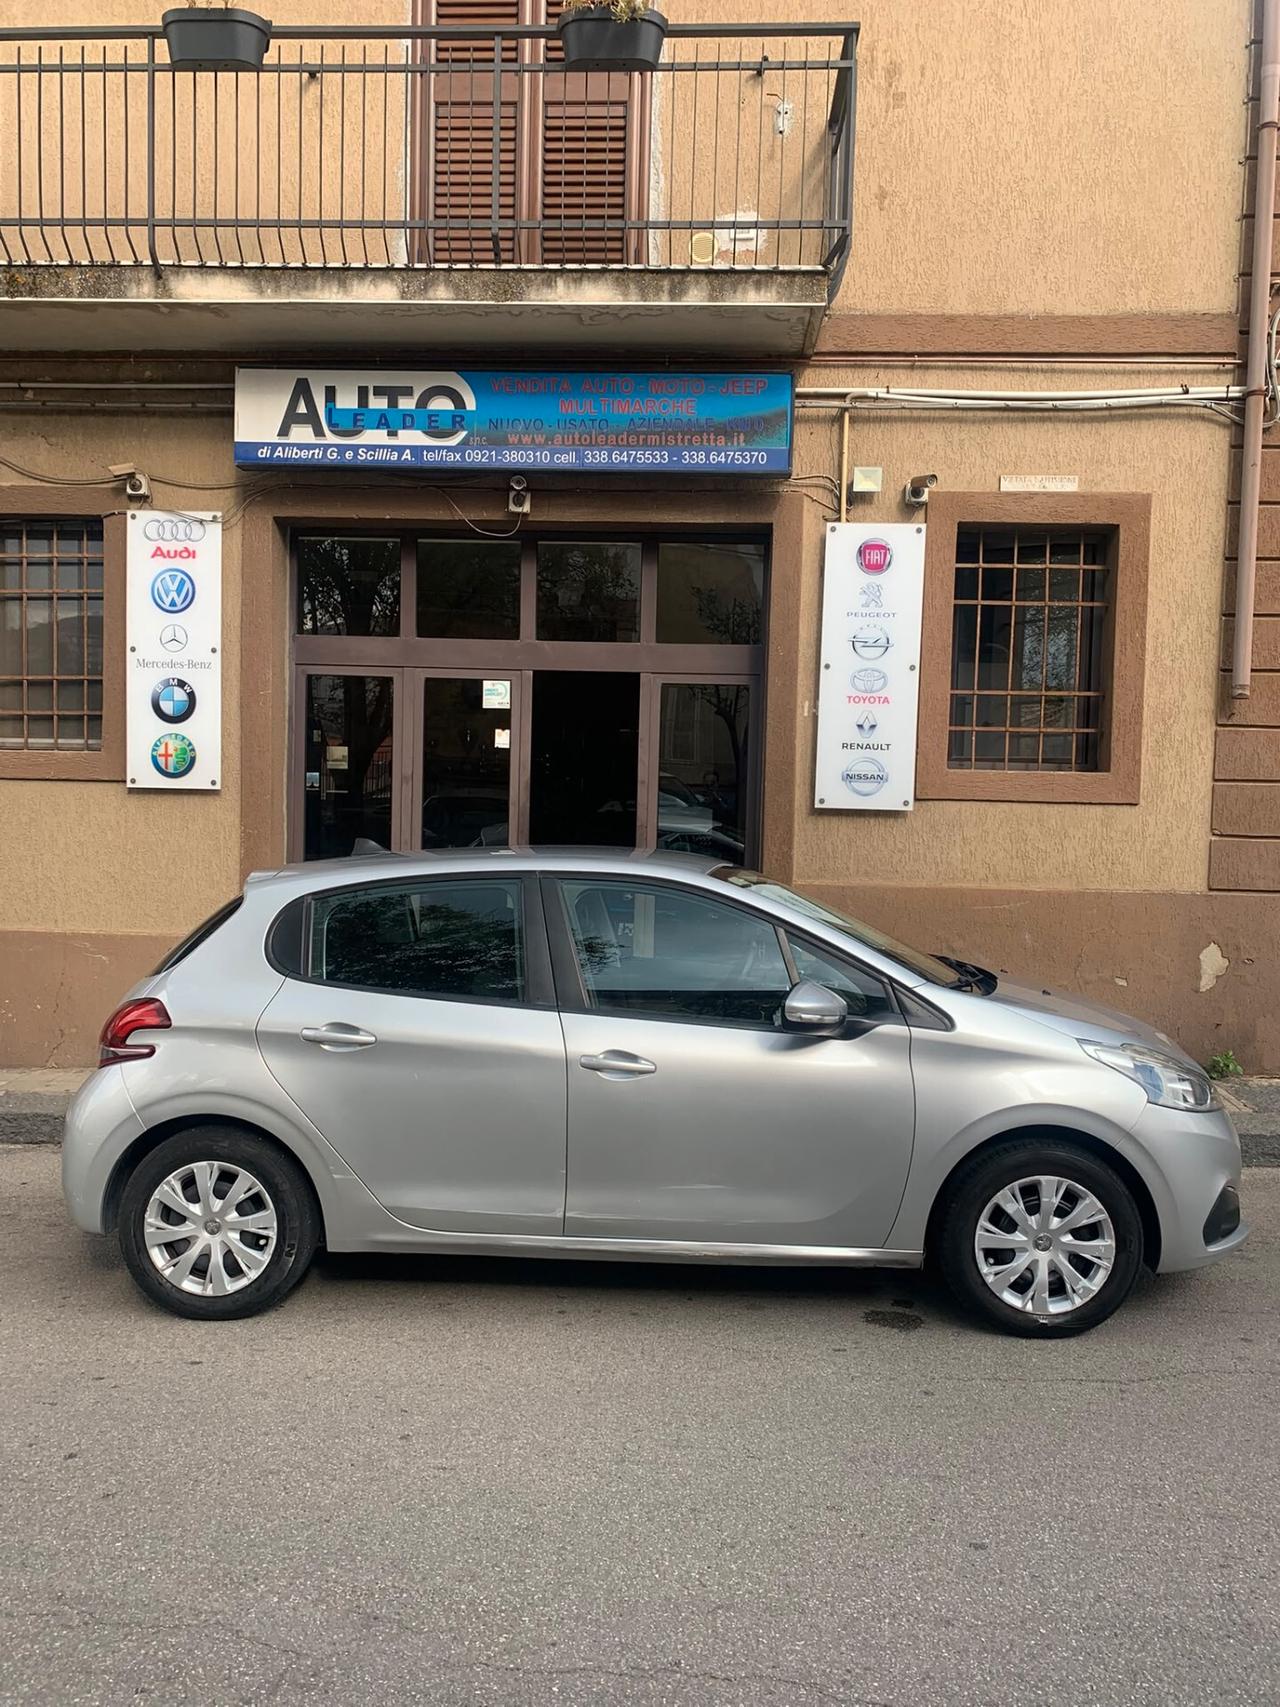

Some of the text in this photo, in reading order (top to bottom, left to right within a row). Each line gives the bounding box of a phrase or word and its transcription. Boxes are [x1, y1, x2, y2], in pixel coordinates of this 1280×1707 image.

[491, 377, 572, 394] VENDITA
[582, 378, 634, 394] AUTO
[652, 378, 705, 395] MOTO
[720, 379, 768, 395] JEEP
[277, 377, 468, 439] AUTO
[560, 398, 697, 415] MULTIMARCHE
[327, 407, 466, 430] LEADER
[488, 418, 544, 431] NUOVO
[557, 418, 609, 431] USATO
[627, 417, 714, 431] AZIENDALE
[507, 431, 746, 447] www.autoleadermistretta.it
[258, 446, 270, 458] di
[273, 446, 324, 459] Aliberti
[327, 448, 341, 459] G.
[345, 450, 354, 459] e
[357, 448, 398, 461] Scillia
[401, 449, 415, 461] A.
[423, 450, 461, 462] tel/fax
[465, 450, 550, 463] 0921-380310
[554, 451, 579, 463] cell.
[584, 451, 669, 463] 338.6475533
[681, 452, 767, 464] 338.6475370
[151, 546, 196, 559] Audi
[865, 549, 885, 565] FIAT
[136, 658, 212, 670] Mercedes-Benz
[847, 695, 890, 705] TOYOTA
[841, 742, 891, 751] RENAULT
[845, 773, 884, 781] NISSAN
